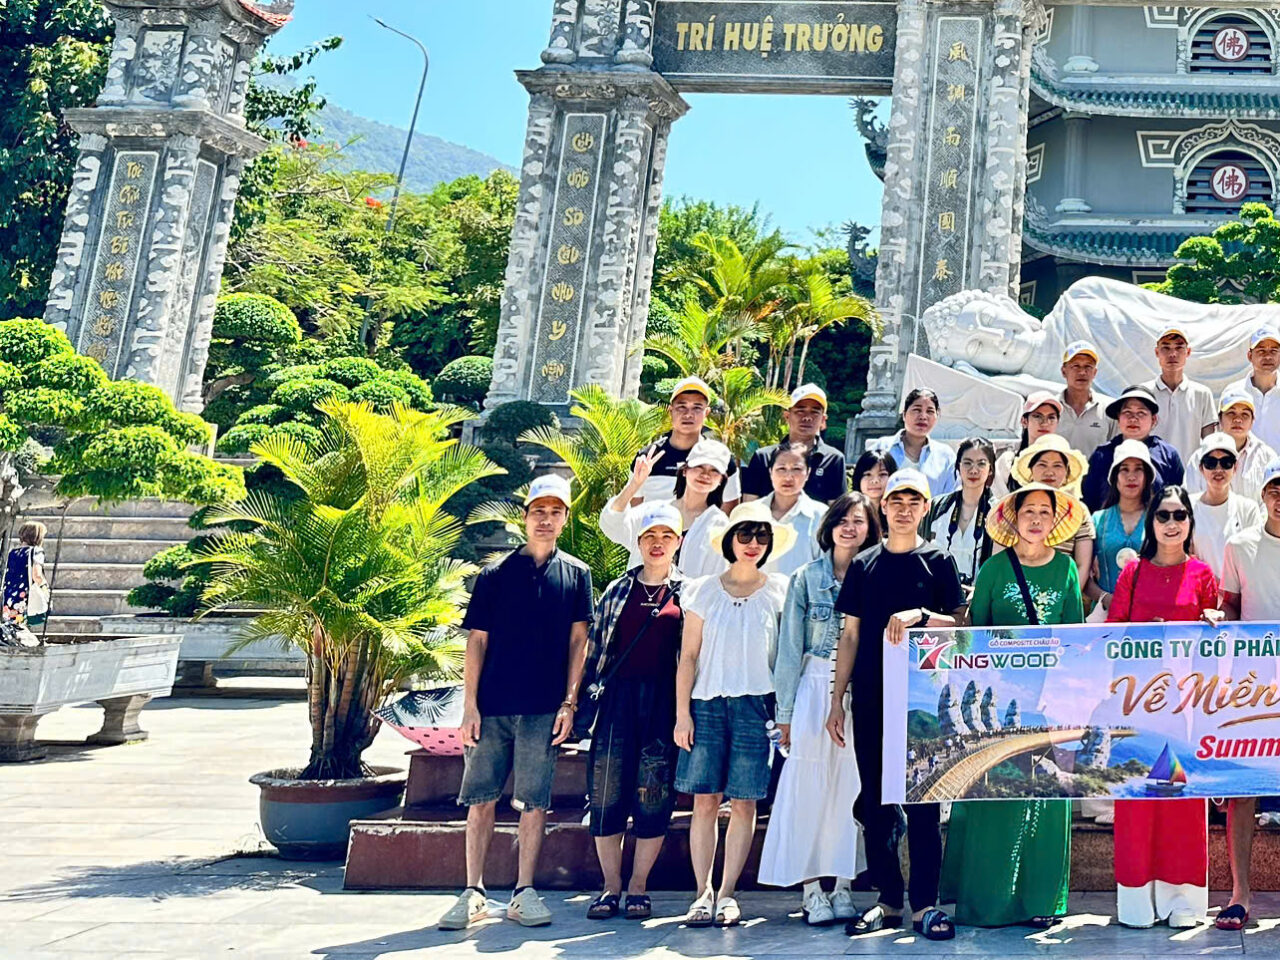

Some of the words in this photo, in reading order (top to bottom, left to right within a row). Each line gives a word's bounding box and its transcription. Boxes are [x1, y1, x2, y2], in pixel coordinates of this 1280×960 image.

[676, 15, 716, 51] TRÍ
[723, 15, 774, 58] HUỆ
[784, 13, 883, 52] TRƯỞNG
[1218, 31, 1243, 56] 佛
[1217, 168, 1242, 195] 佛
[1107, 637, 1162, 658] CÔNG
[1170, 641, 1192, 657] TY
[1200, 633, 1227, 657] CỔ
[1110, 671, 1173, 715] Về
[1172, 671, 1280, 715] Miền
